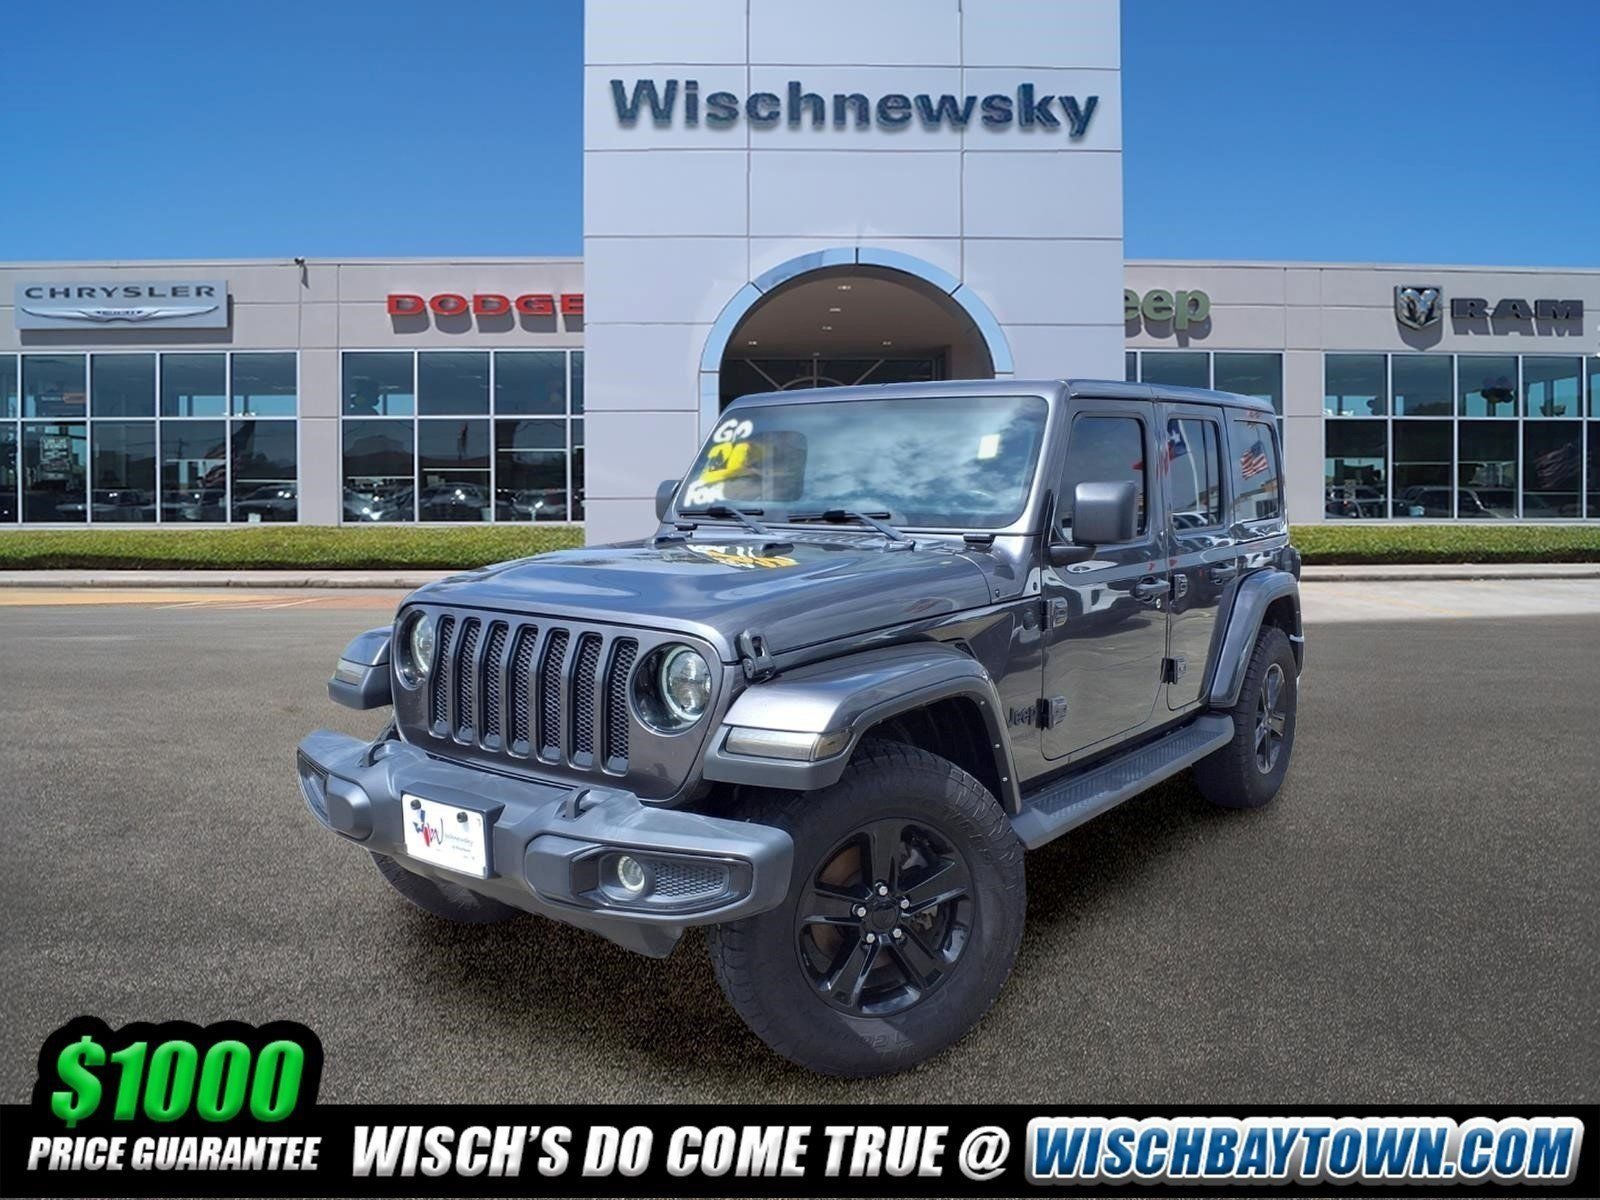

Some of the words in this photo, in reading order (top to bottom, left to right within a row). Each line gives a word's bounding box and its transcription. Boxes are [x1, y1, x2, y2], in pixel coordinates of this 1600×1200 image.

[609, 78, 1099, 139] Wischnewsky
[23, 283, 216, 300] CHRYSLER
[1124, 289, 1210, 330] eep
[1450, 298, 1584, 320] RAM
